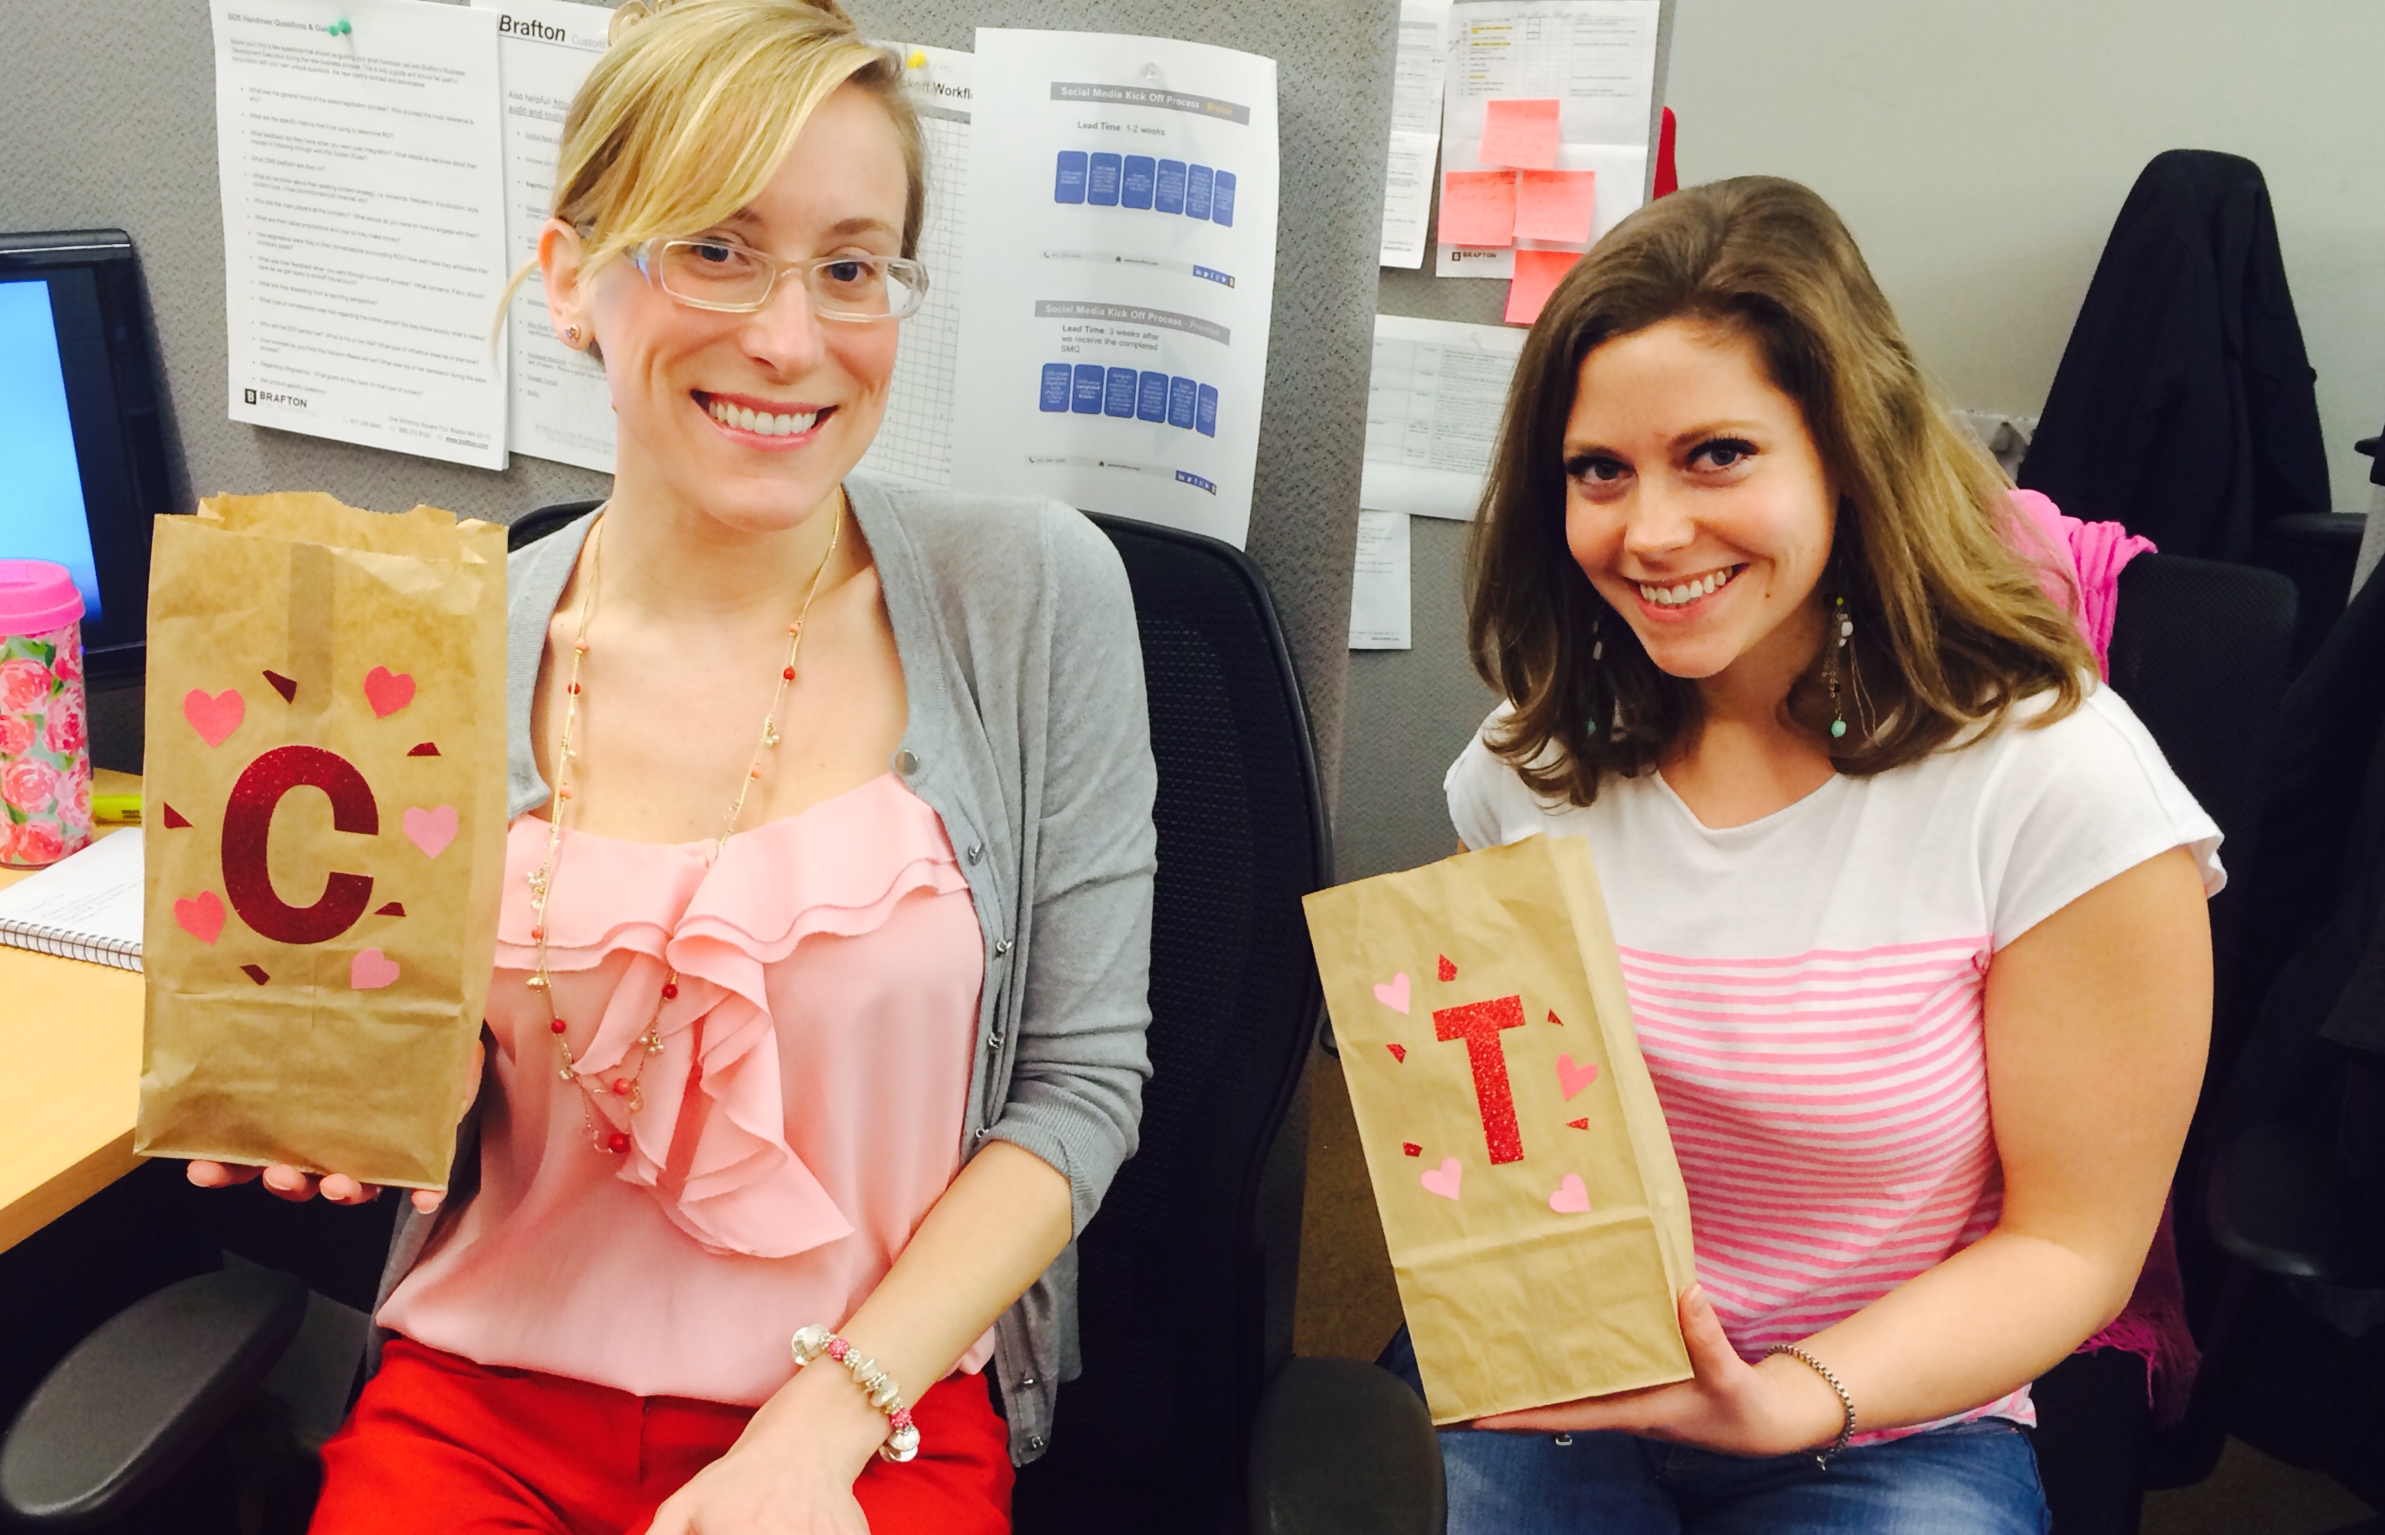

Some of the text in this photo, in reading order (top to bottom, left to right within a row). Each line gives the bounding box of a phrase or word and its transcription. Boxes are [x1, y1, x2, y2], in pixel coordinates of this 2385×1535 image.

[274, 18, 307, 30] Questions
[499, 14, 566, 42] Brafton
[933, 82, 973, 100] Workfl
[1061, 86, 1090, 97] Social
[1092, 88, 1123, 99] Media
[1125, 89, 1146, 101] Kick
[1149, 92, 1164, 103] Off
[1166, 95, 1200, 109] Process
[1077, 121, 1098, 130] Lead
[1126, 124, 1138, 133] 1-2
[1140, 127, 1165, 136] weeks
[1045, 304, 1074, 314] Social
[1076, 306, 1105, 316] Media
[1107, 308, 1128, 318] Kick
[1130, 310, 1145, 320] Off
[1148, 312, 1182, 327] Process
[1062, 324, 1082, 332] Lead
[1116, 329, 1140, 338] weeks
[1142, 331, 1159, 341] after
[1074, 336, 1103, 344] receive
[1104, 338, 1116, 346] the
[1119, 339, 1158, 351] completed
[260, 391, 307, 408] BRAFTON
[221, 745, 379, 945] C
[1432, 994, 1526, 1166] T
